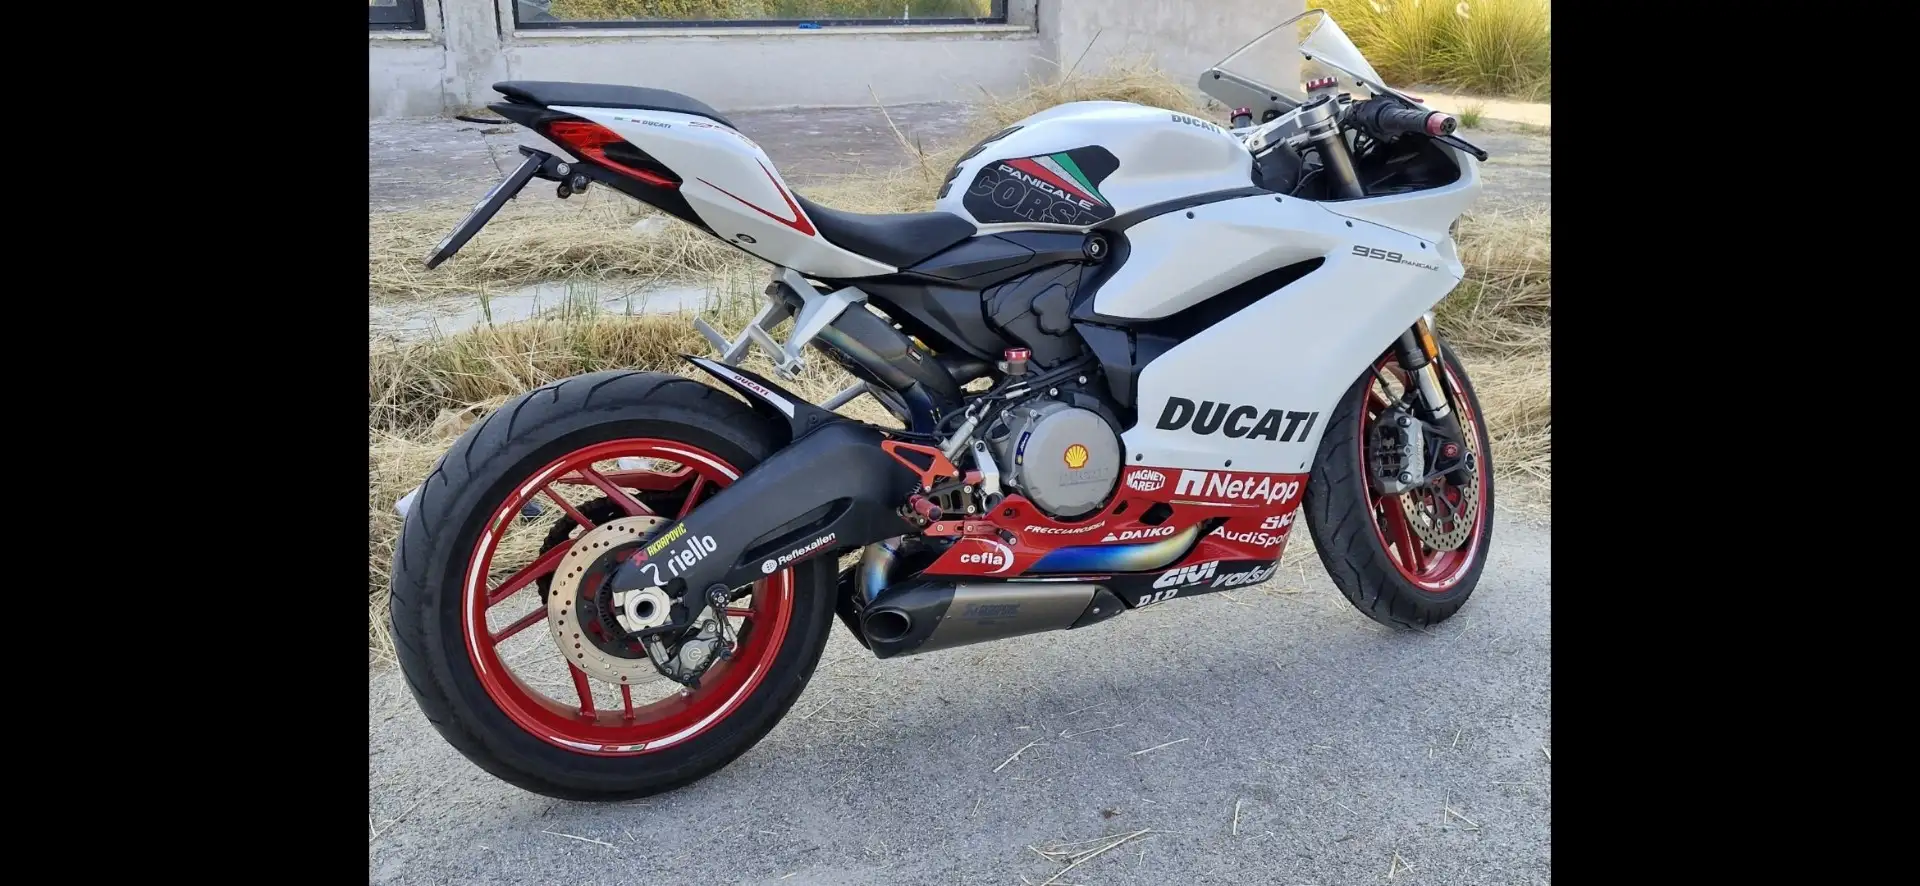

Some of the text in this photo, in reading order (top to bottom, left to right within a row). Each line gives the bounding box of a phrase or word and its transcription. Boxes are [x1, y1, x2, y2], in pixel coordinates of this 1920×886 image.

[642, 119, 672, 129] DUCATI
[1172, 114, 1221, 134] DUCATI
[998, 164, 1095, 211] PANIGALE
[1352, 245, 1403, 263] 959
[734, 375, 769, 396] DUCATI
[1156, 396, 1320, 443] DUCATI
[1206, 473, 1299, 504] NetApp
[1119, 526, 1175, 540] DAIKO
[667, 535, 717, 578] riello
[777, 532, 836, 566] Reflexallen
[960, 552, 1003, 565] cefla
[1152, 560, 1219, 589] GIVI
